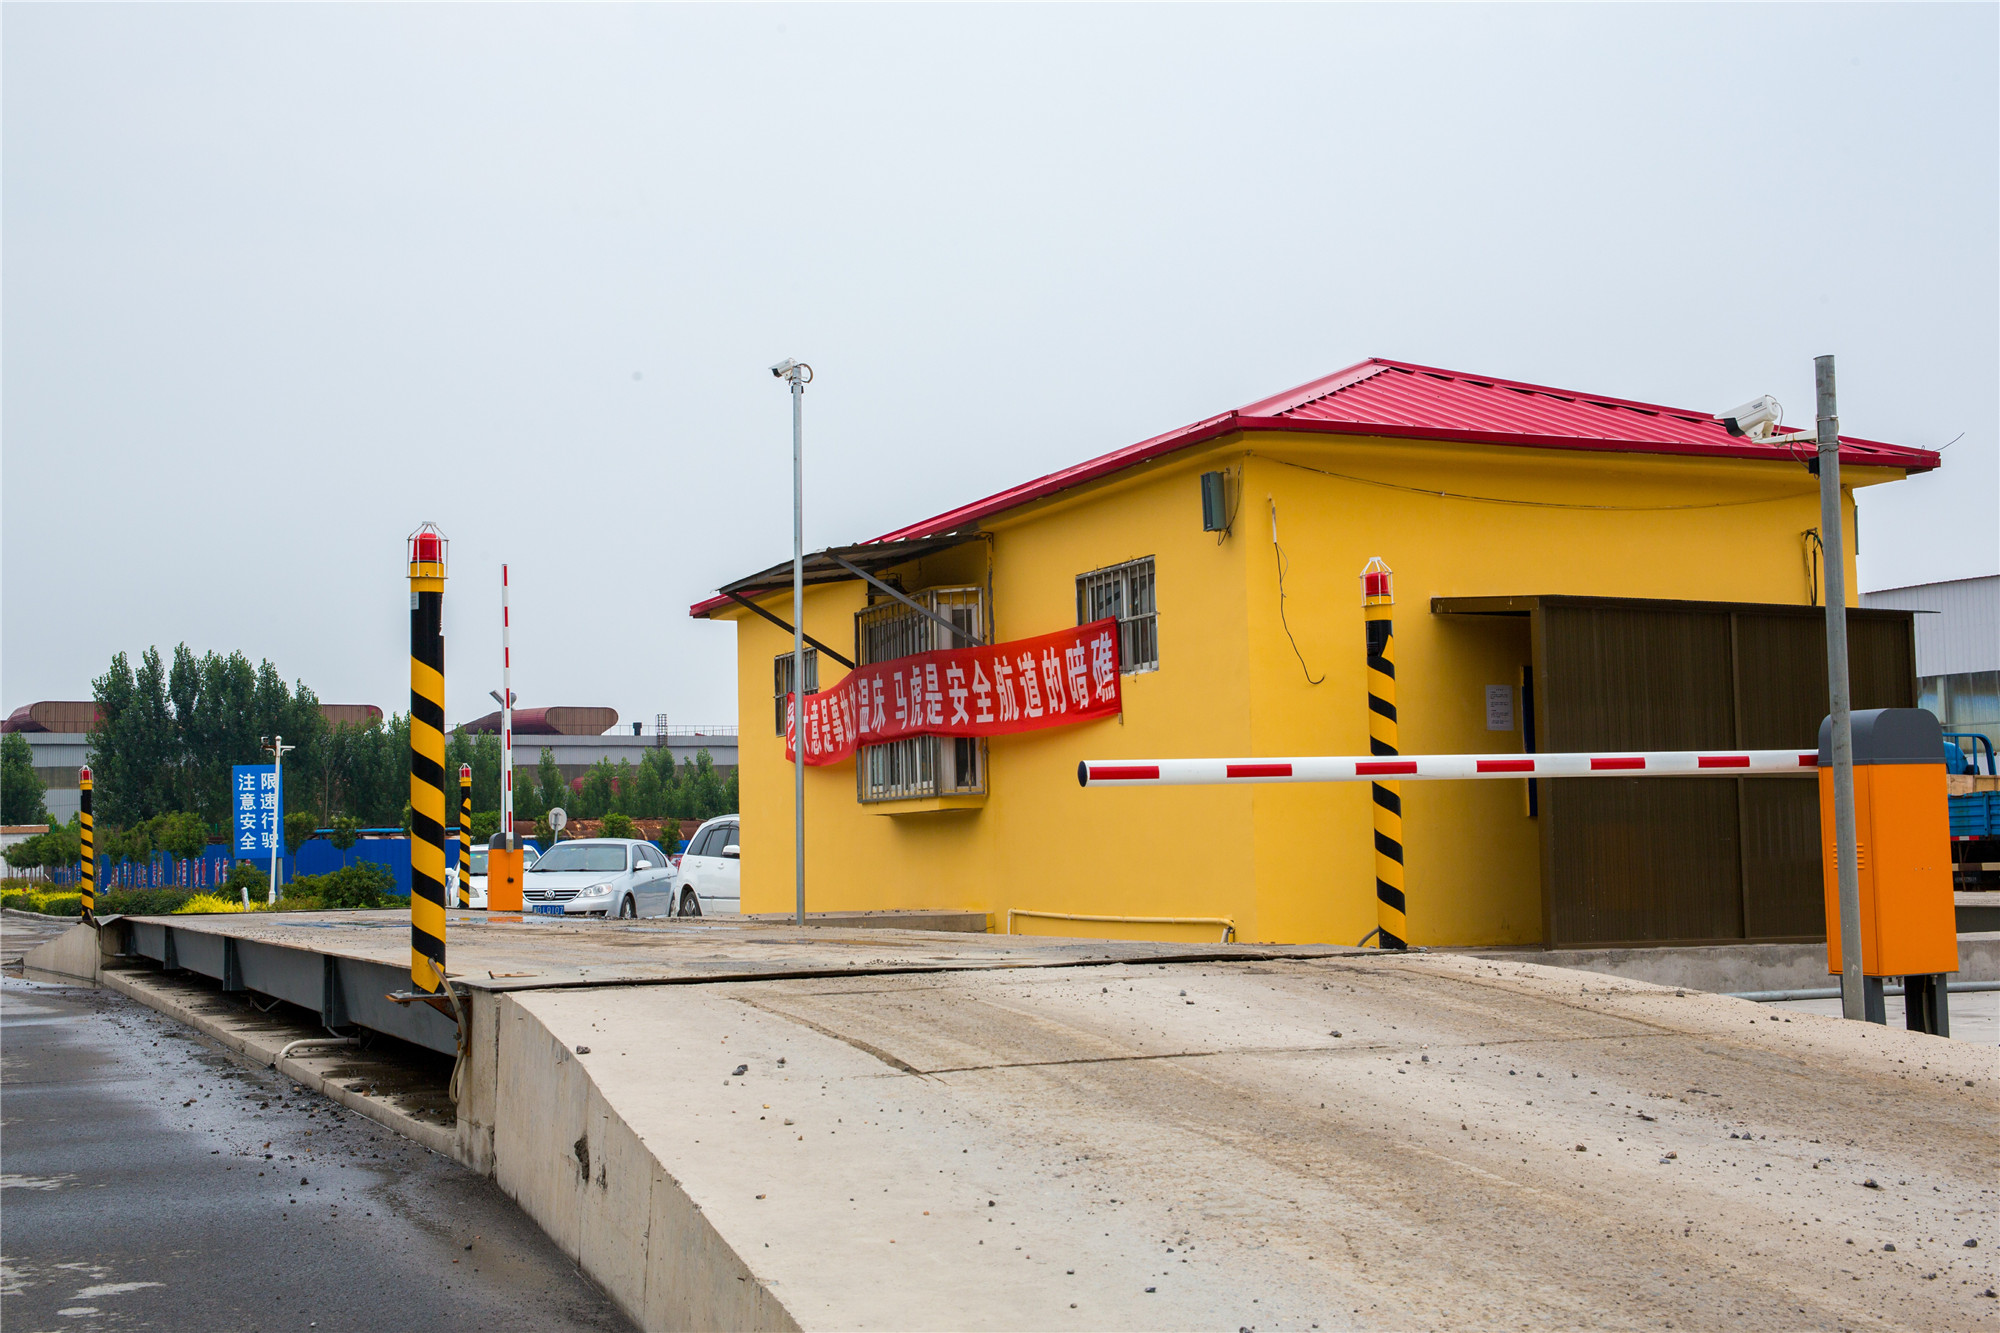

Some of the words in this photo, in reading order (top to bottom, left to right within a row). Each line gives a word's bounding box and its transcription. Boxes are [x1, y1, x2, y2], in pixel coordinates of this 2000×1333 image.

[238, 772, 256, 850] 注意安全
[260, 772, 279, 848] 限速行驶
